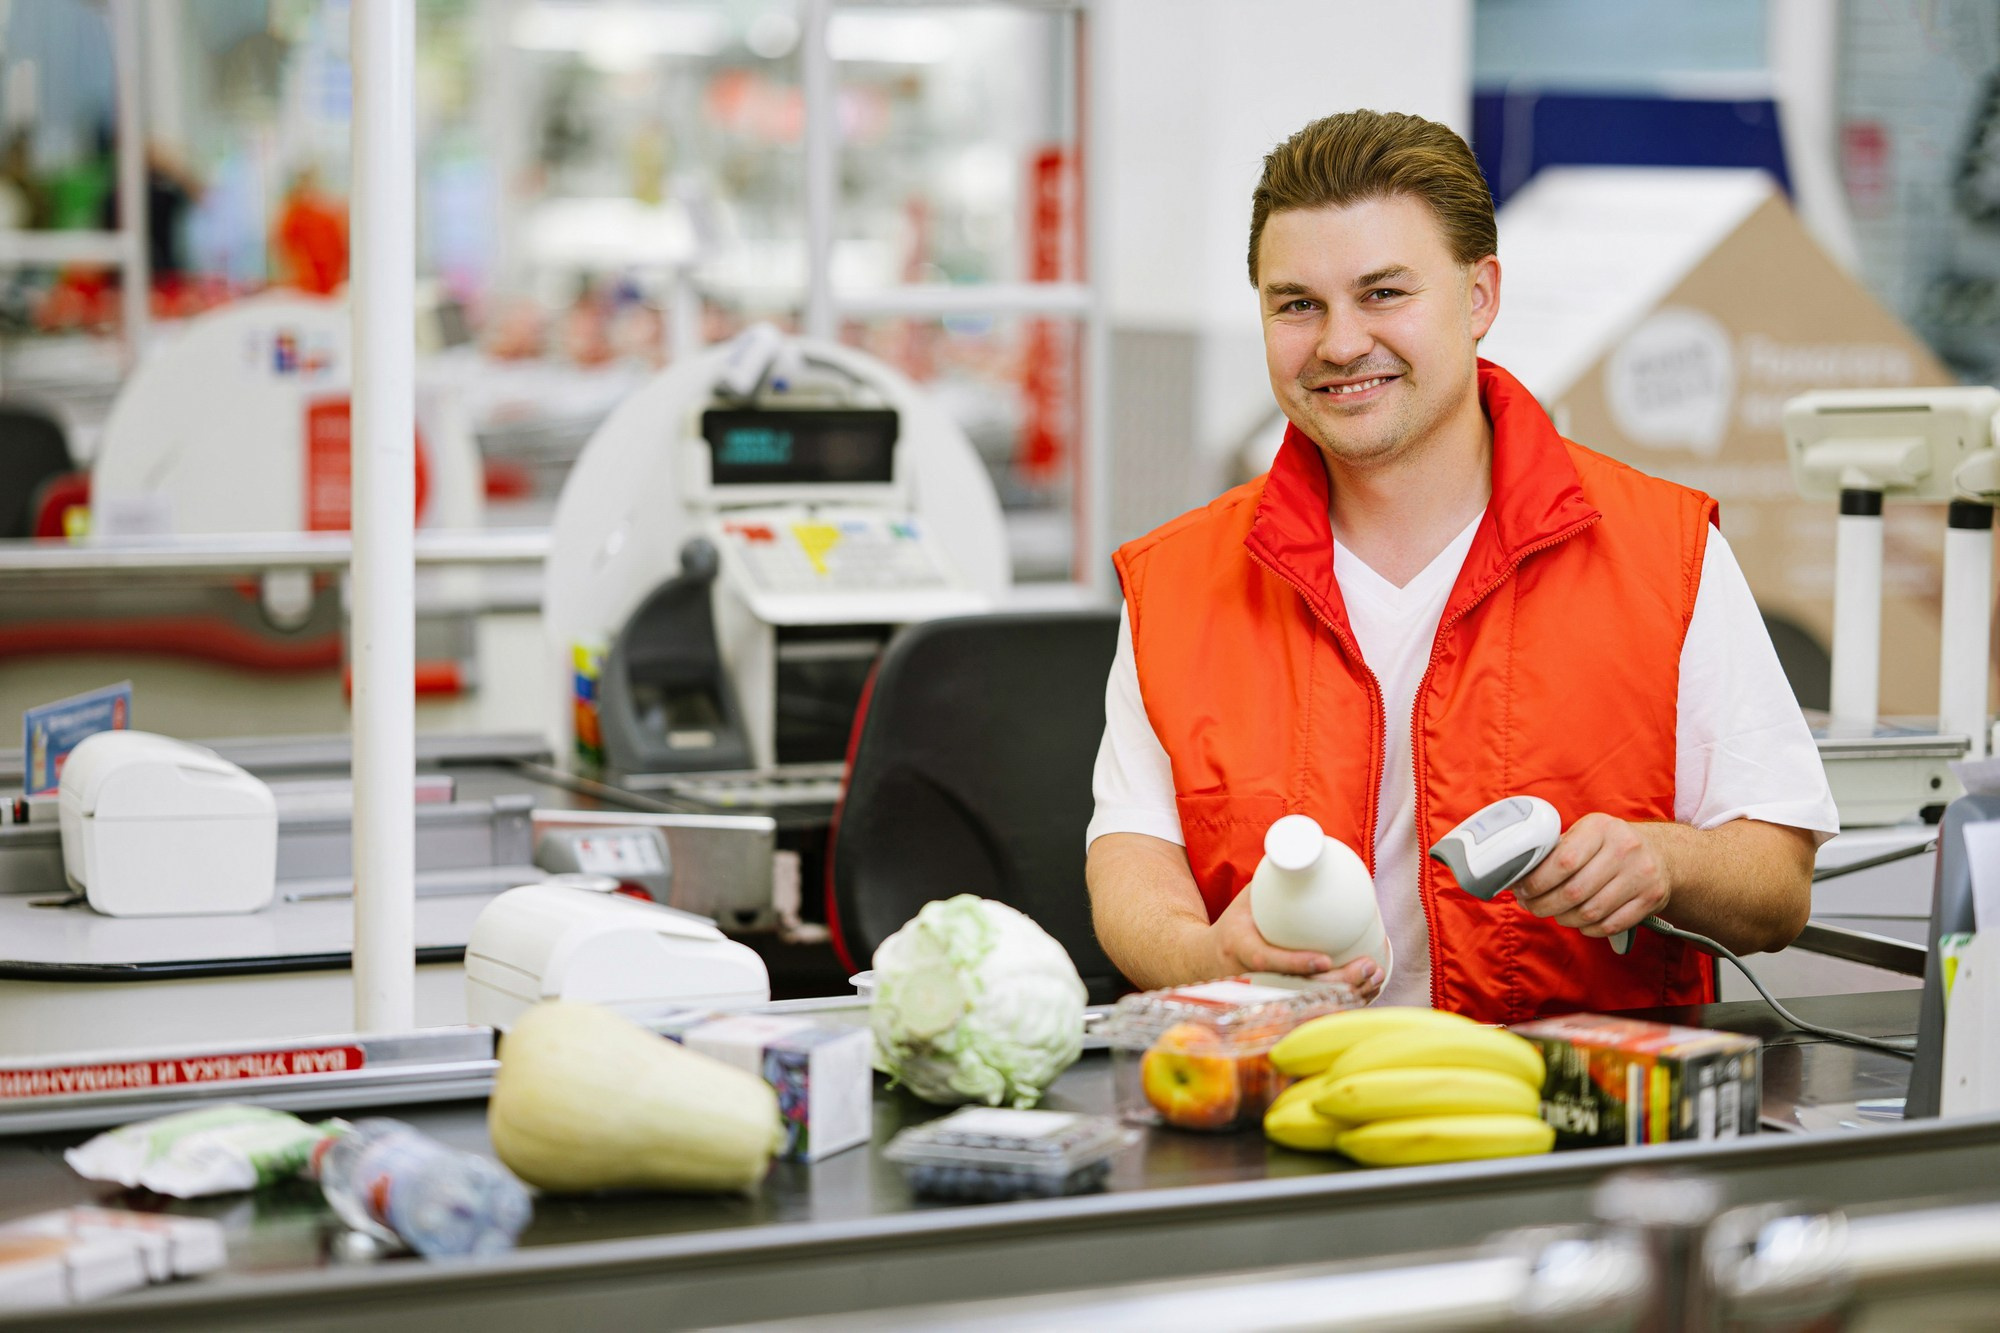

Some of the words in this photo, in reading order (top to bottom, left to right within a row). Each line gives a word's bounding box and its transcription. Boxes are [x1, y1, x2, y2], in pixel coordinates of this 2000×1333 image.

[156, 1061, 176, 1084] И
[181, 1052, 288, 1082] УЛЫБКА
[292, 1049, 347, 1075] ВАМ
